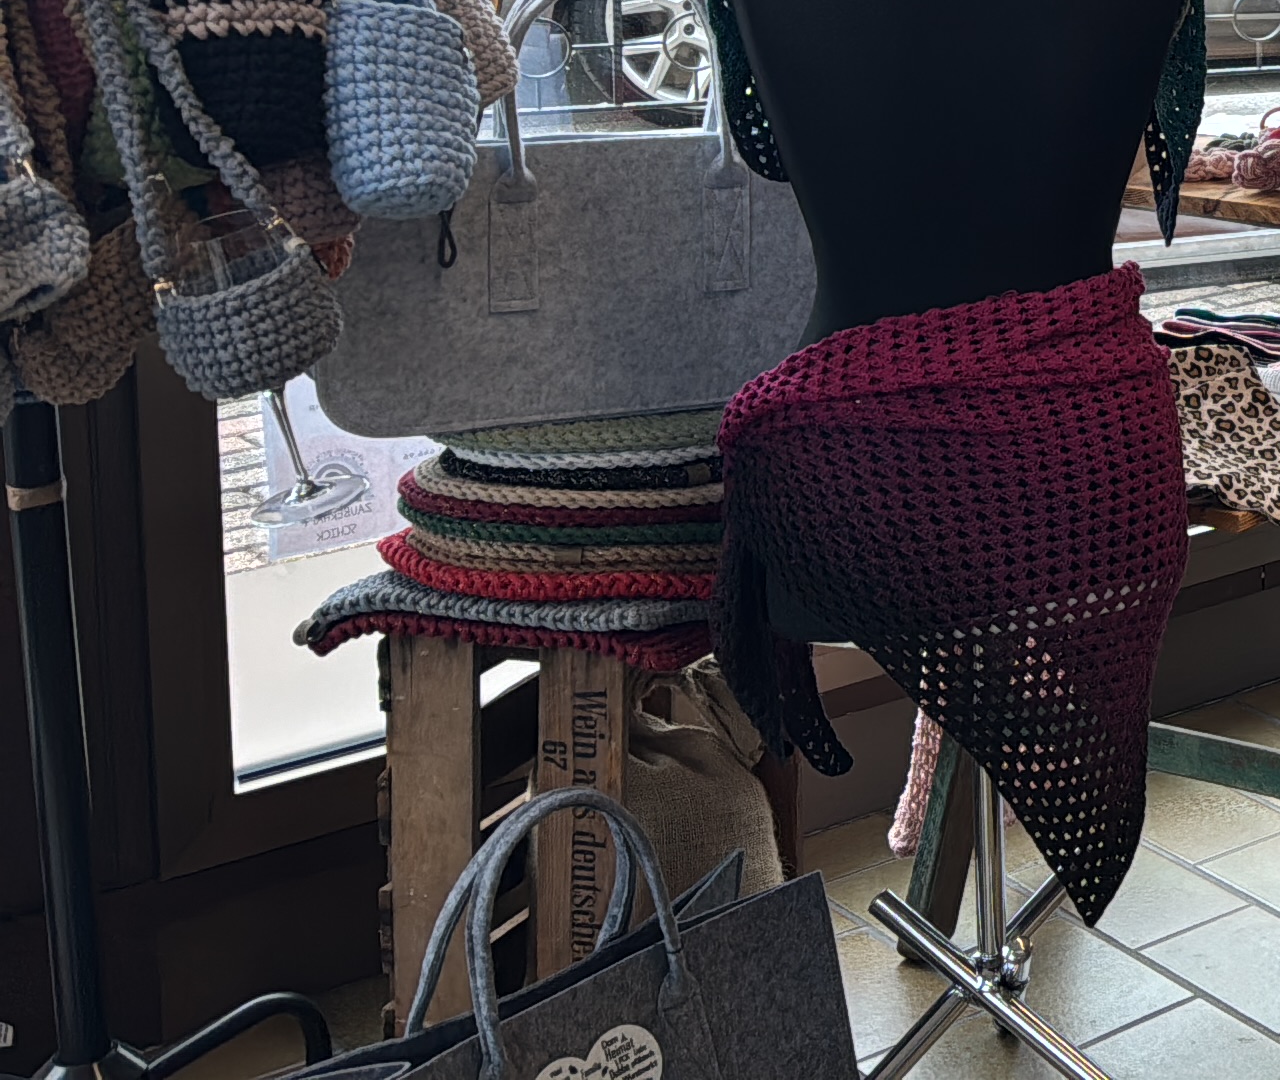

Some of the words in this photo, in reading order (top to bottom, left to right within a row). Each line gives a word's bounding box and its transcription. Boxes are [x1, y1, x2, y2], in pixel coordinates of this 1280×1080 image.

[572, 688, 608, 760] Wein
[542, 739, 568, 771] 67
[572, 769, 597, 820] as
